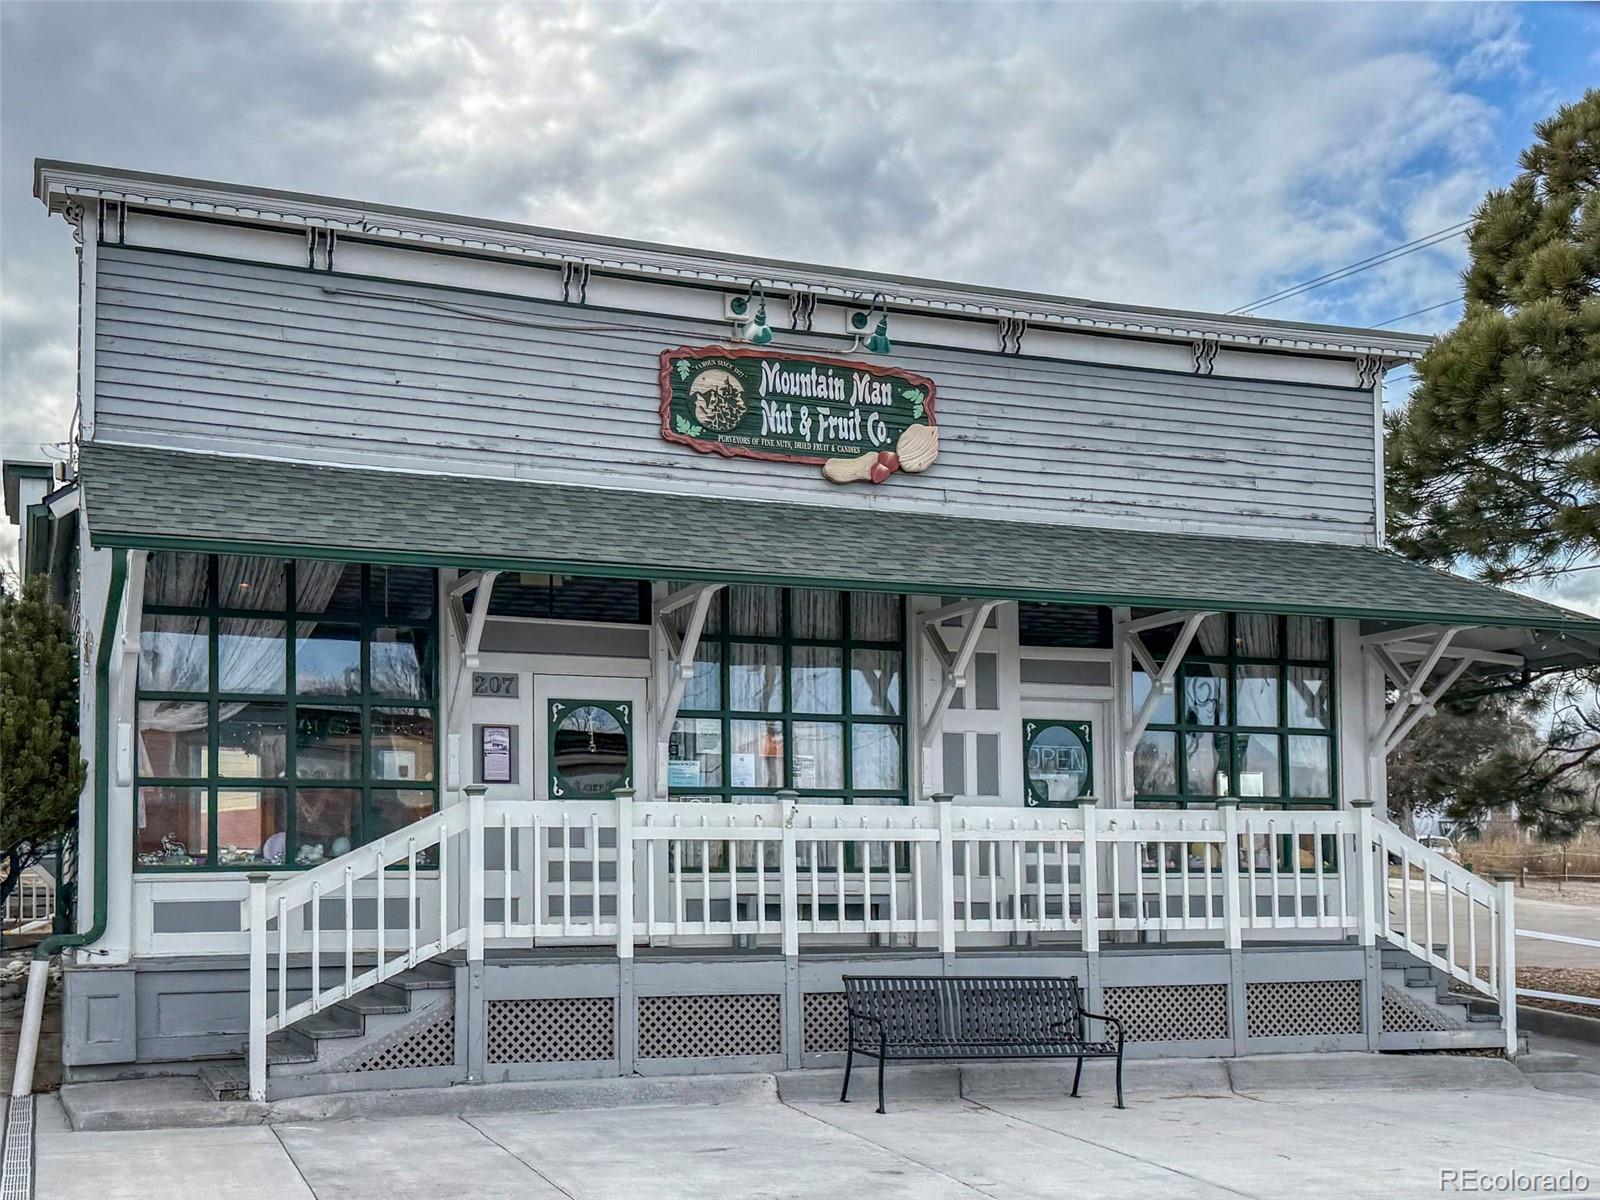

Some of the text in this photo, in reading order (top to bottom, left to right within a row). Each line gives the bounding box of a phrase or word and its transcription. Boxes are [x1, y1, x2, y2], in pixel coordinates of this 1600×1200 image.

[759, 360, 892, 407] Mountain Man
[760, 400, 892, 447] Nut & Fruit Co.
[717, 434, 751, 445] PURVEYORS
[751, 437, 760, 446] OF
[761, 438, 775, 447] FINE
[794, 441, 812, 450] DRIED
[812, 443, 829, 452] FRUIT
[836, 445, 861, 454] CANDIES
[473, 675, 515, 694] 207
[1027, 748, 1084, 769] OPEN
